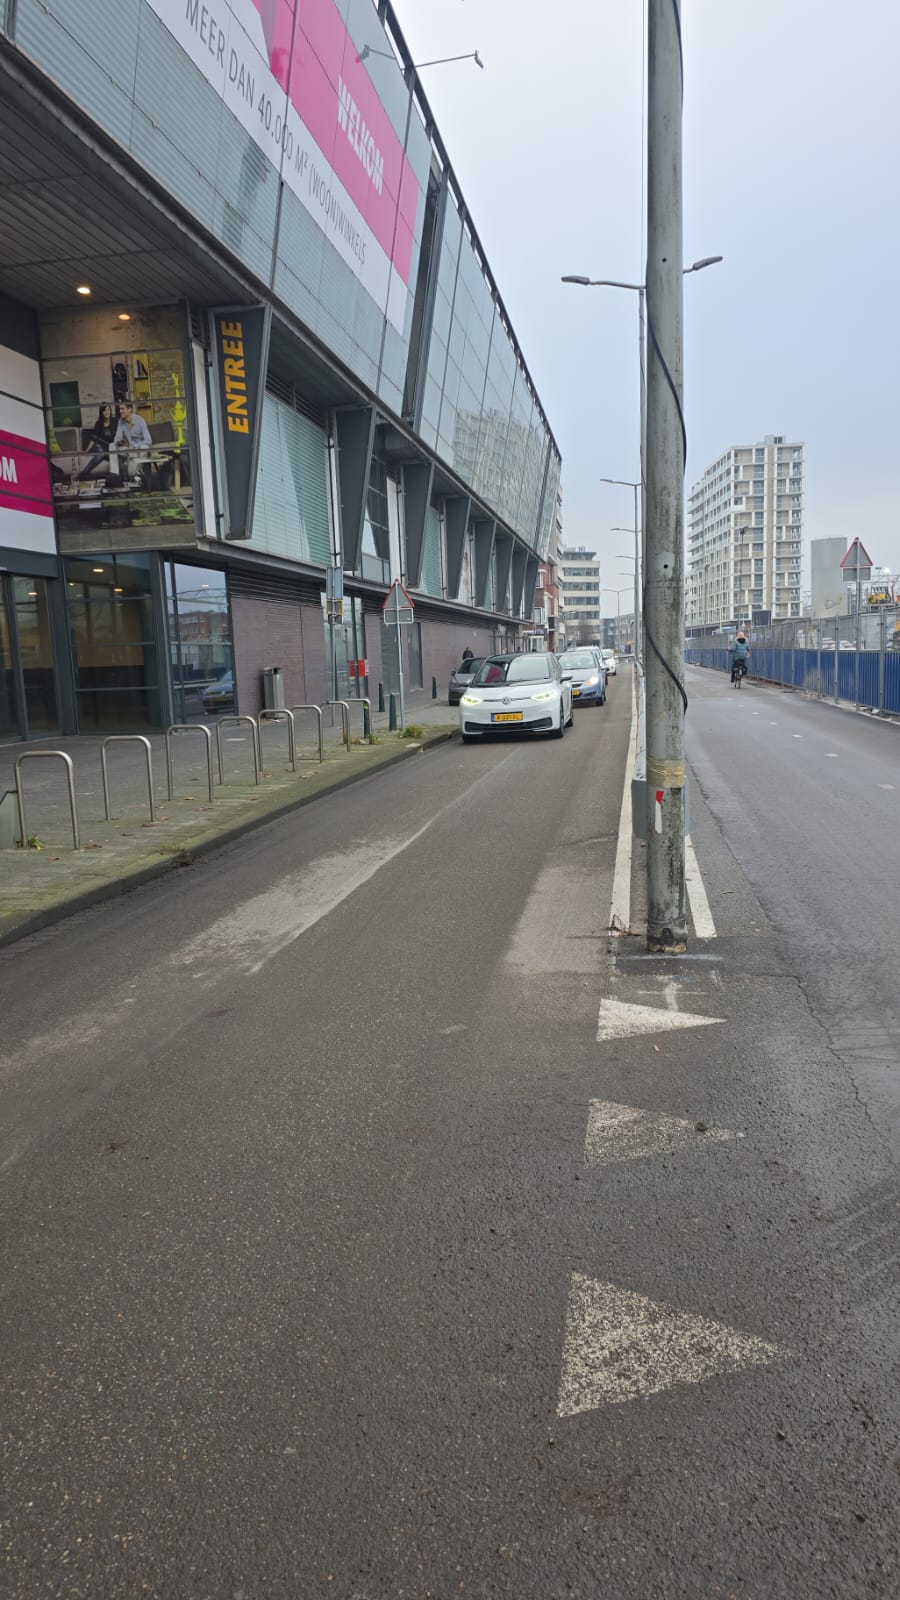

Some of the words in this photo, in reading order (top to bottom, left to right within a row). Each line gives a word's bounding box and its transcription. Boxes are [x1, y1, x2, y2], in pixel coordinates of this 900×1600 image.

[186, 0, 225, 68] MEER
[229, 48, 255, 109] DAN
[258, 92, 293, 160] 40.000
[338, 75, 384, 196] WELKOM
[221, 320, 249, 434] ENTREE
[0, 455, 18, 484] M
